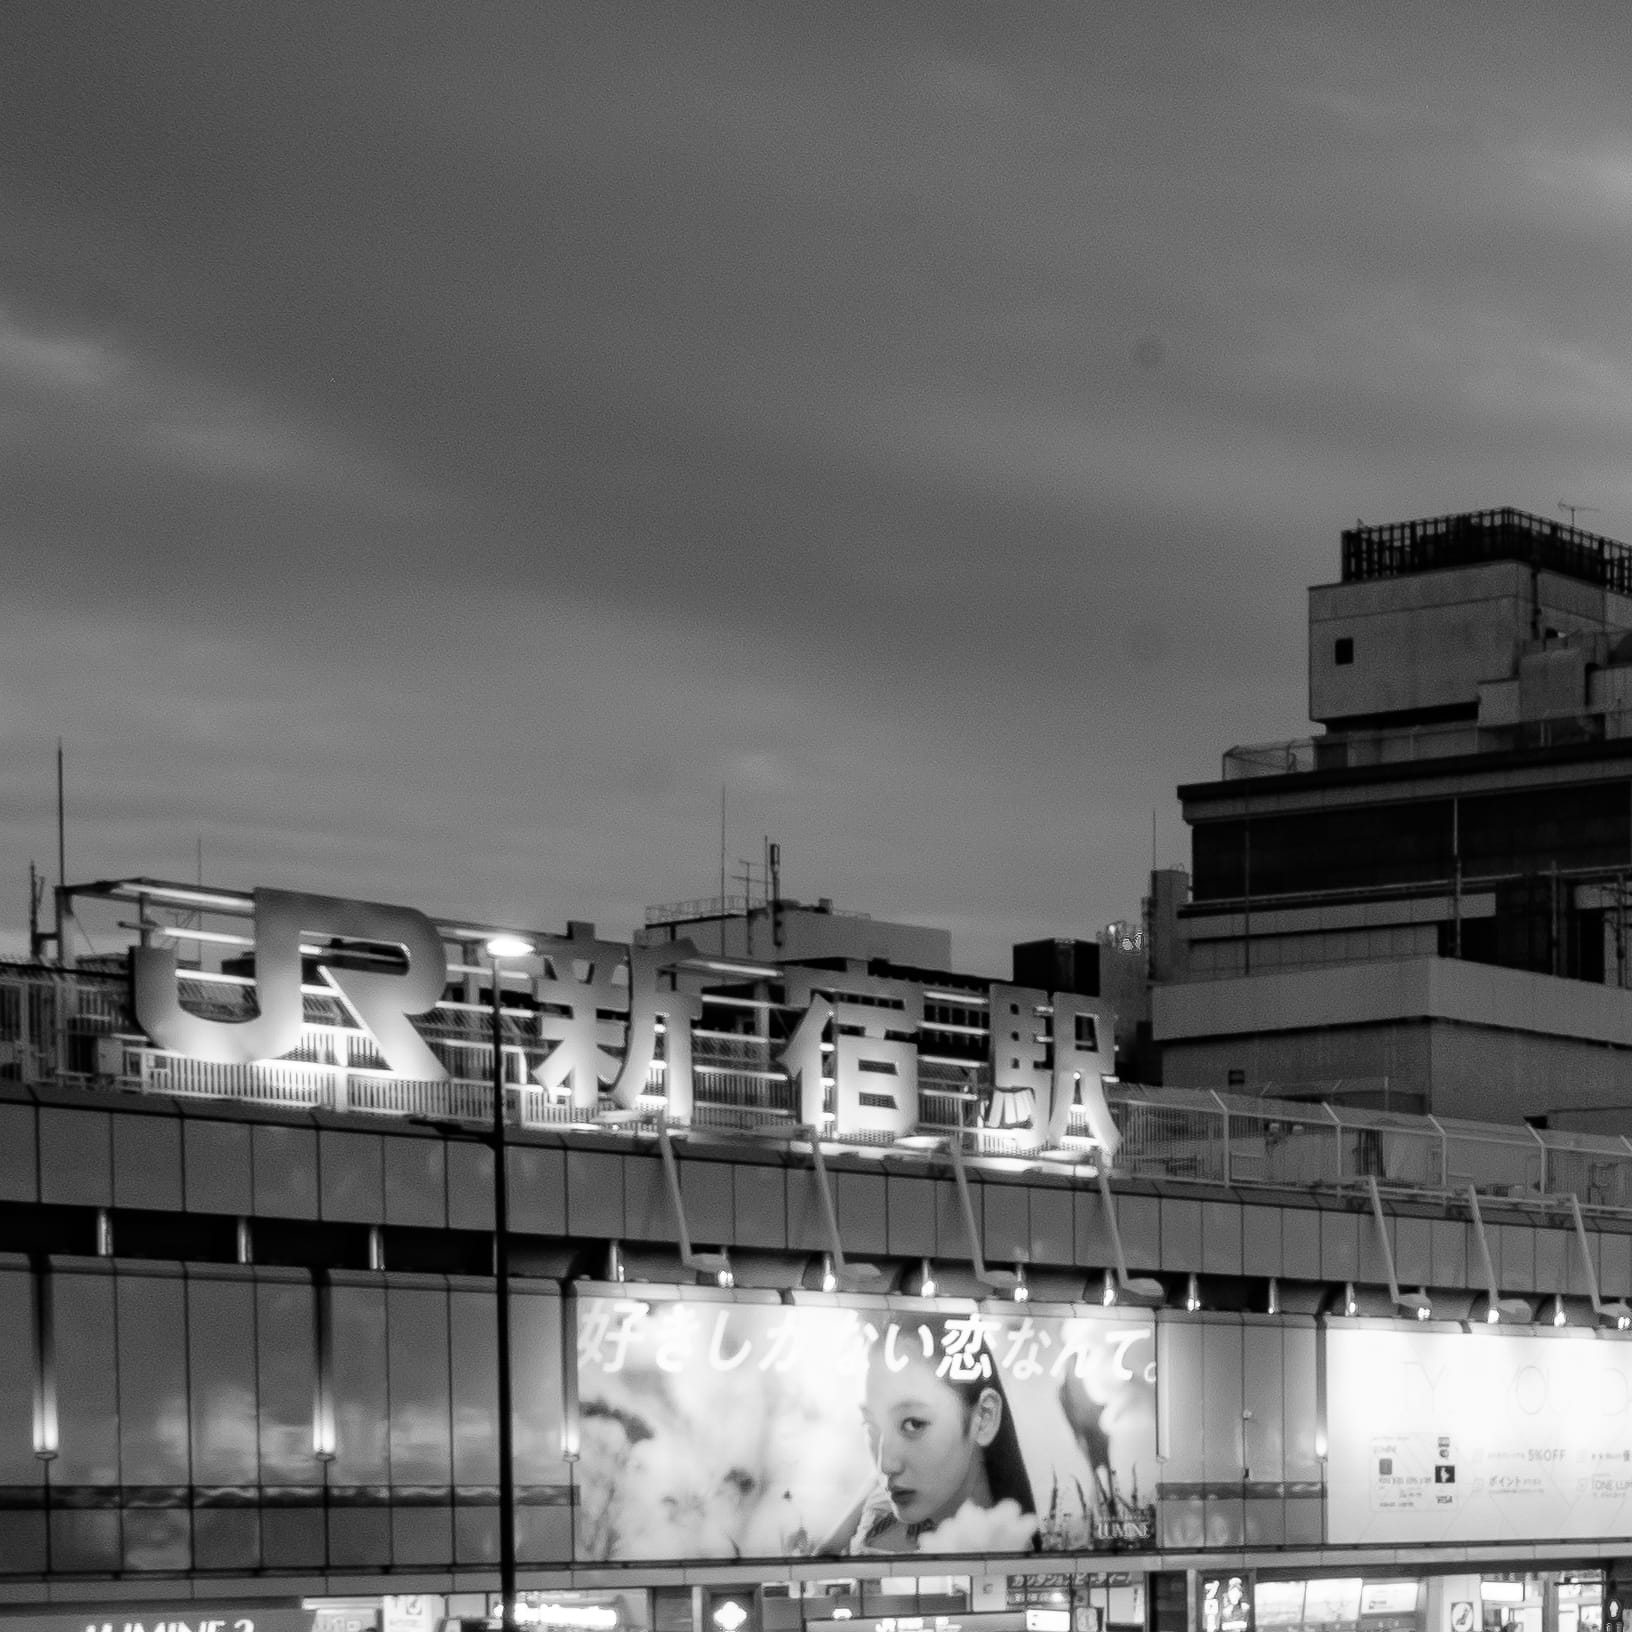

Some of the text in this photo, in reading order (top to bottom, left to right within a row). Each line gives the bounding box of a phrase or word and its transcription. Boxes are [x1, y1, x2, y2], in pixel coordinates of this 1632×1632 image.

[133, 886, 1123, 1160] JR 新宿駅
